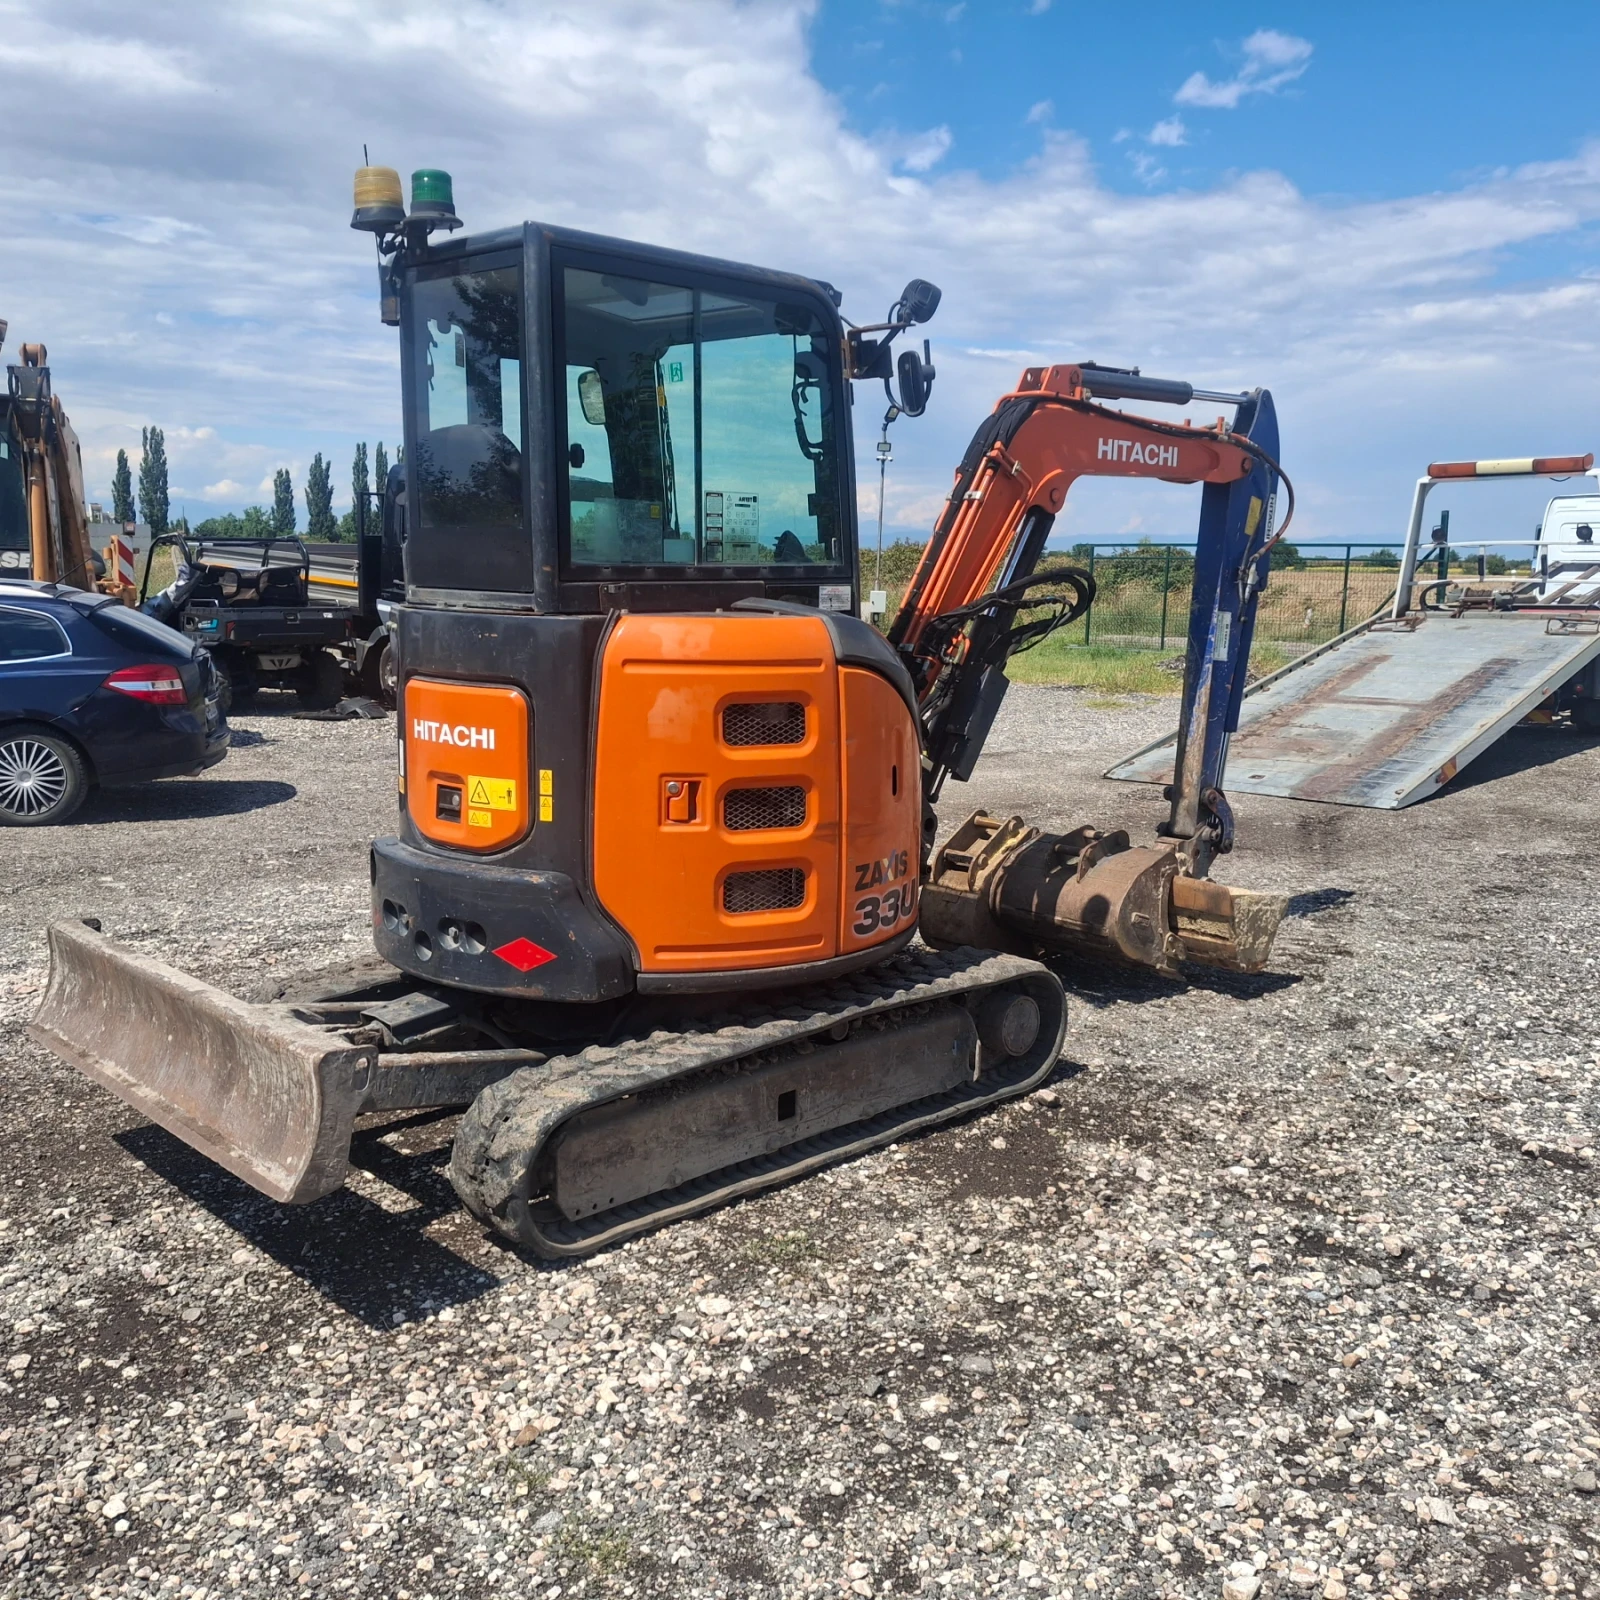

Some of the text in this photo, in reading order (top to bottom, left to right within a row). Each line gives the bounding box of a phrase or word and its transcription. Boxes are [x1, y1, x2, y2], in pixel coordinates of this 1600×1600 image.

[1098, 437, 1178, 467] HITACHI
[1266, 496, 1275, 540] HITACHI
[0, 551, 33, 568] SE
[413, 718, 495, 750] HITACHI
[855, 848, 908, 892] ZAXIS
[853, 878, 916, 937] 33U
